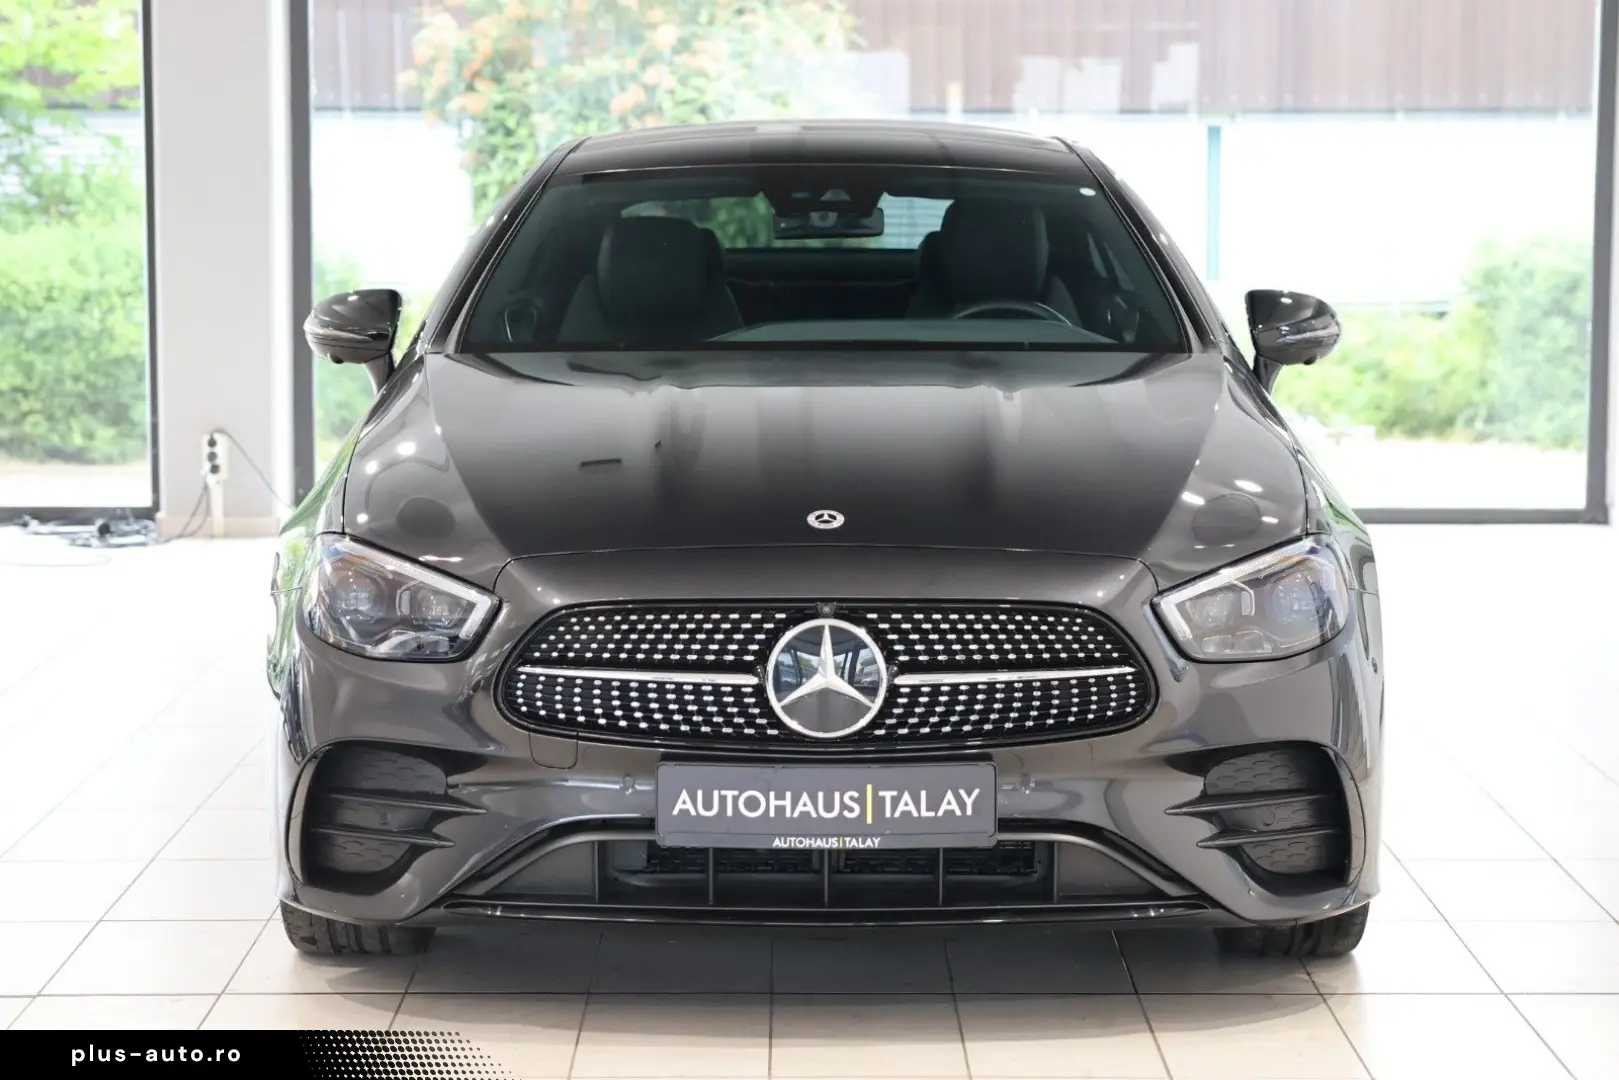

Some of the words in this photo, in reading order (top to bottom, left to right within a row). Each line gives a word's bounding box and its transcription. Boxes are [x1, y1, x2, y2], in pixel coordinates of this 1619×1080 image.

[672, 788, 861, 819] AUTOHAUS
[878, 788, 981, 818] TALAY
[772, 836, 839, 849] AUTOHAUS
[844, 836, 882, 849] TALAY
